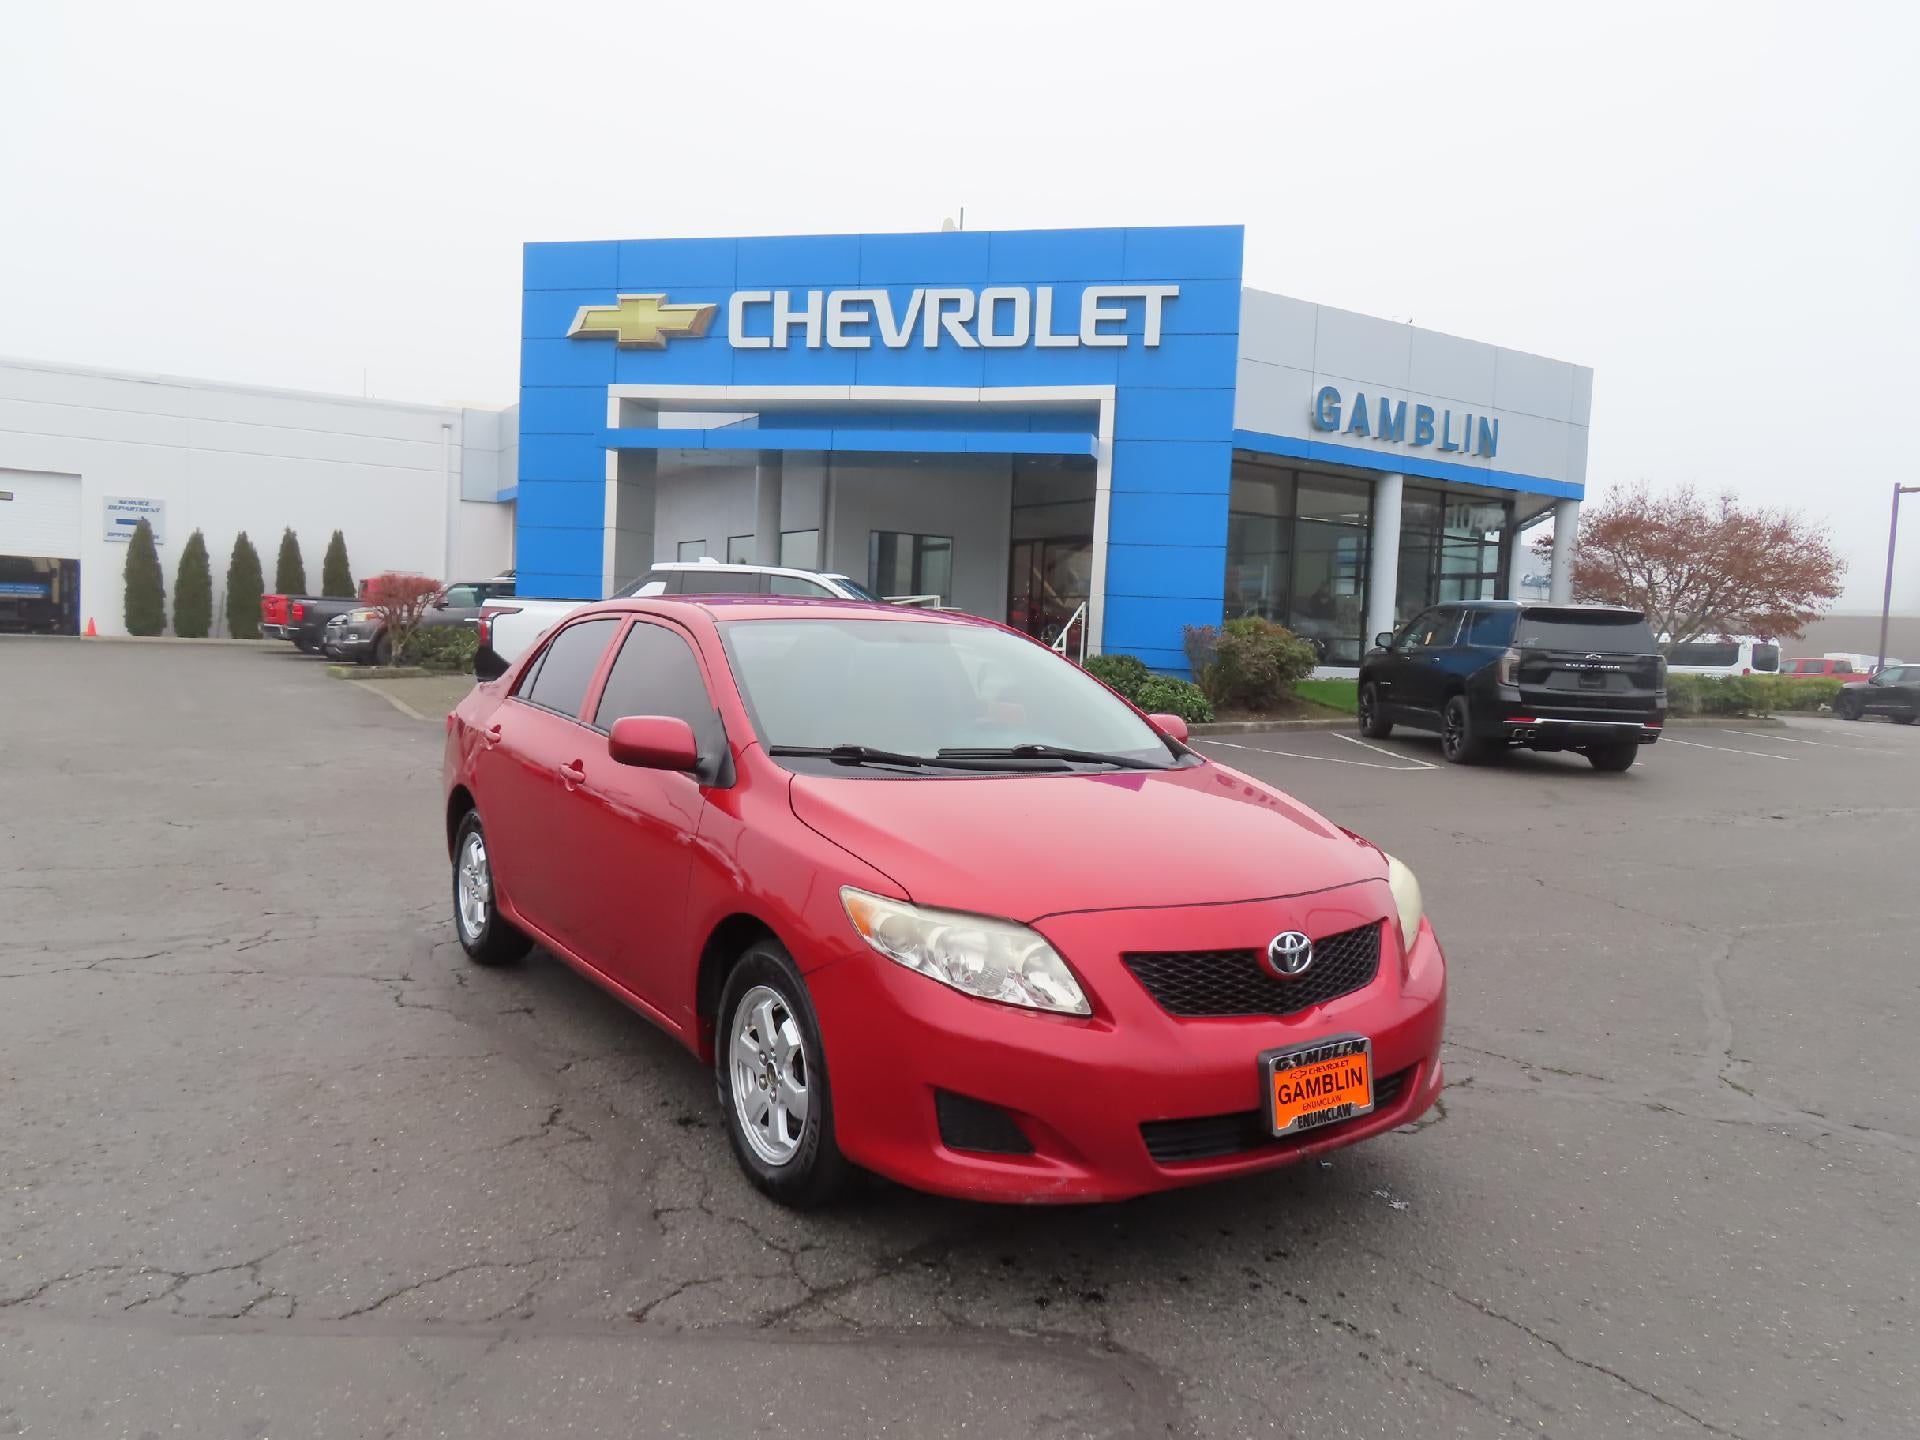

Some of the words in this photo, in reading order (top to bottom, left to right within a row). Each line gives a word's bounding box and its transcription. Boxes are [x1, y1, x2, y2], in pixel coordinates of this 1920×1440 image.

[728, 285, 1180, 349] CHEVROLET
[1314, 386, 1499, 458] GAMBLIN
[1275, 1041, 1366, 1072] GAMBLIN
[1308, 1060, 1349, 1075] CHEVROLET
[1278, 1067, 1363, 1105] GAMBLIN
[1297, 1103, 1352, 1129] ENUMCLAW
[1302, 1096, 1342, 1111] ENUMCLAW
